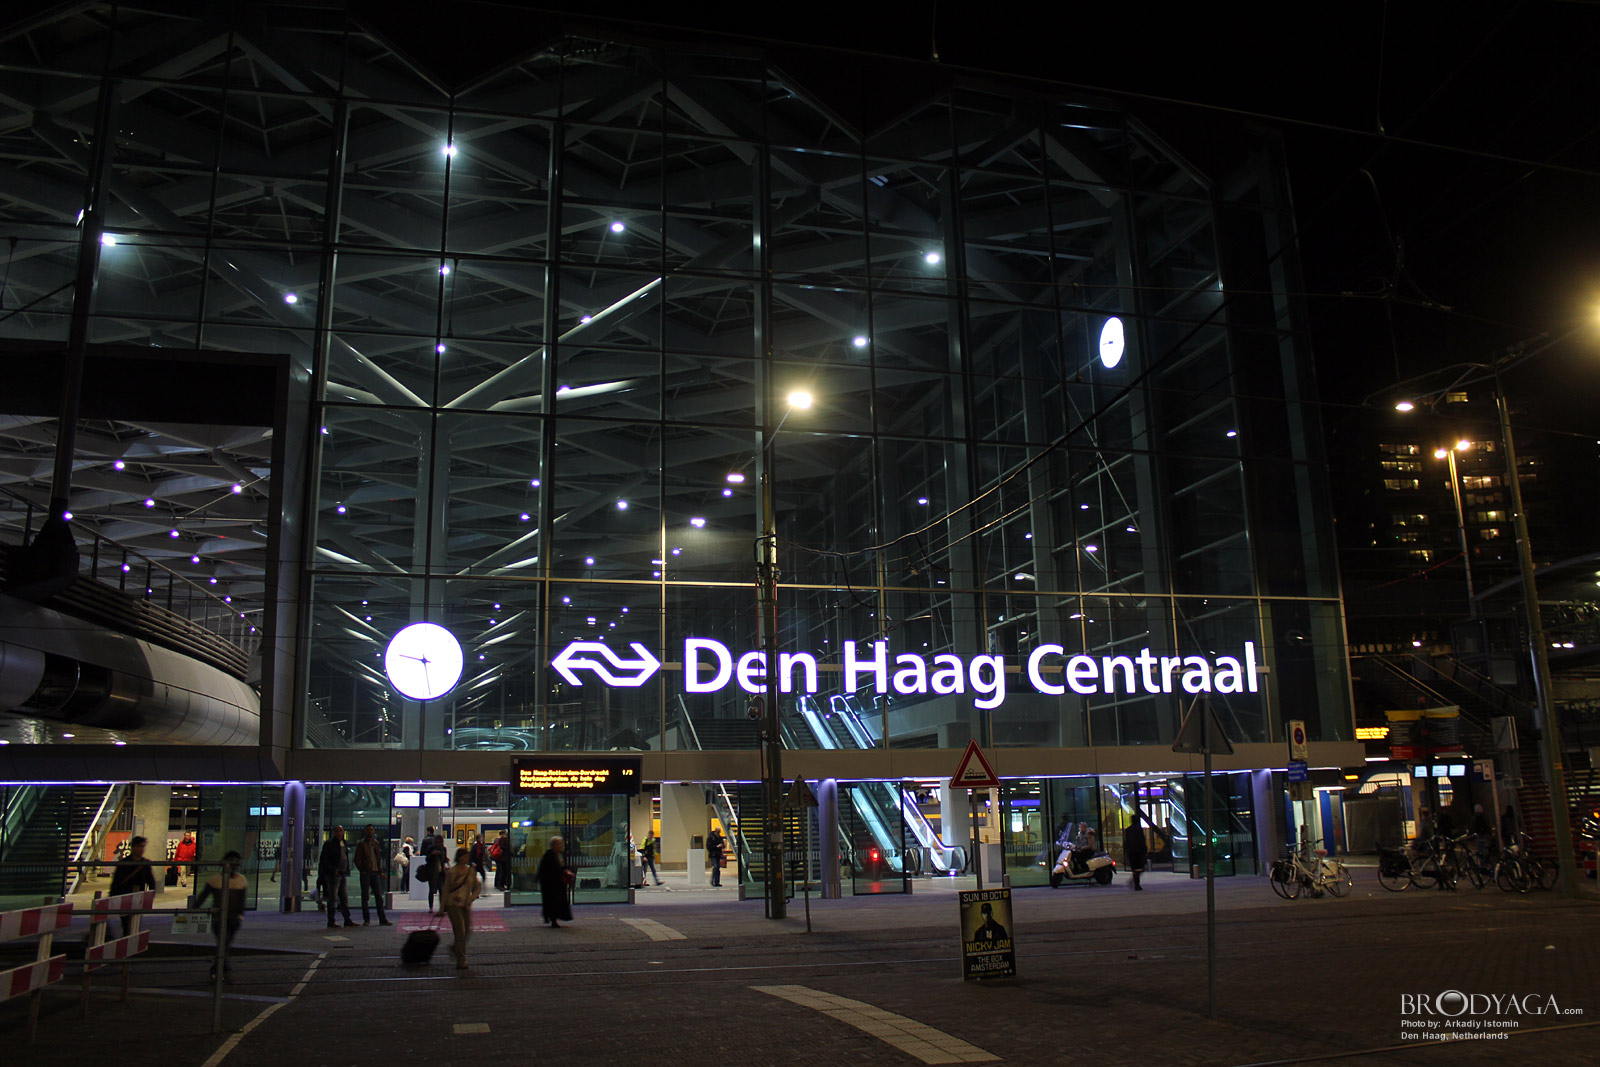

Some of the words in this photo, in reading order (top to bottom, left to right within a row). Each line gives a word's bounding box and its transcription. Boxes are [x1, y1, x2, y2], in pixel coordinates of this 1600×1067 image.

[684, 638, 819, 694] Den
[844, 640, 1006, 710] Haag
[1028, 641, 1259, 695] Centraal
[989, 891, 1002, 900] OCT
[966, 941, 993, 952] NICKY
[994, 939, 1011, 950] JAM
[977, 956, 990, 964] THE
[970, 962, 1010, 972] AMSTERDAM
